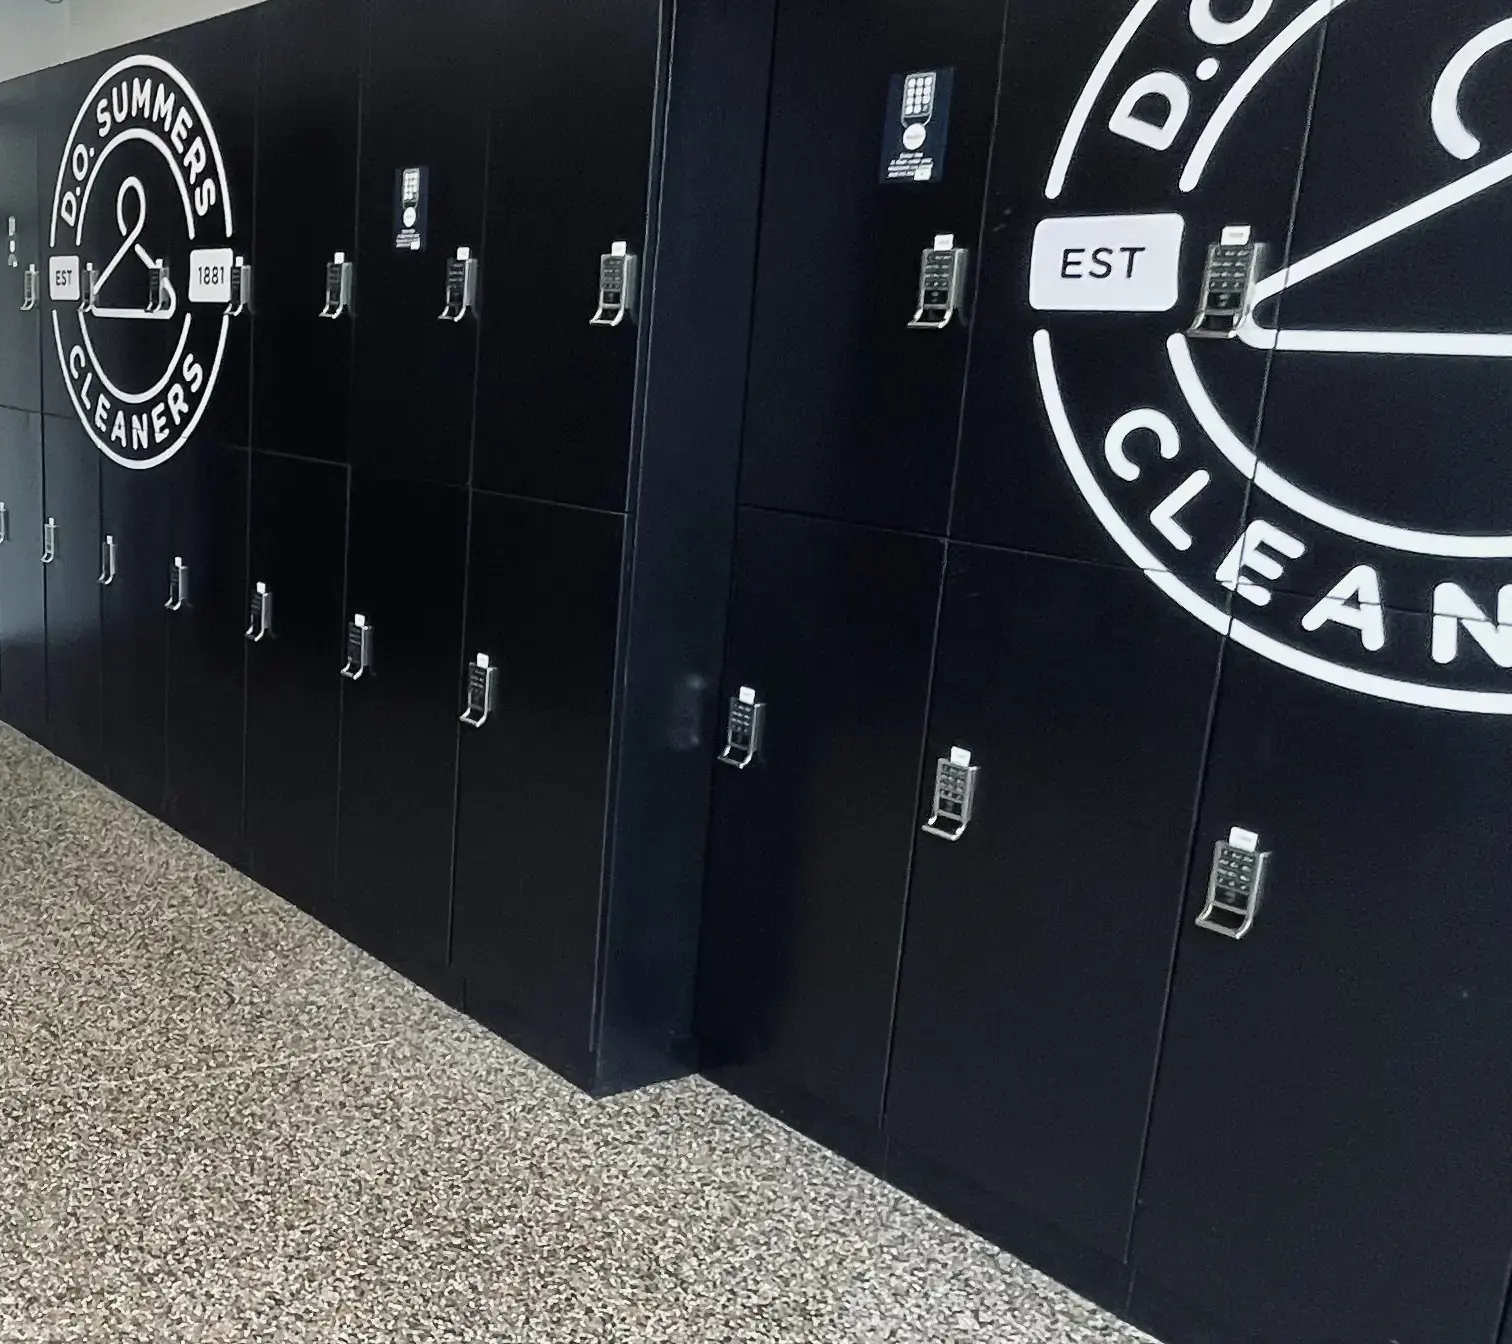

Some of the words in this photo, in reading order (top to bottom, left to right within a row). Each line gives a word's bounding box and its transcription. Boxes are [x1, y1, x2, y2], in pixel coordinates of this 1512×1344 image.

[59, 143, 96, 227] D.O.
[95, 76, 217, 218] SUMMERS
[55, 269, 73, 288] EST
[197, 266, 226, 286] 1881
[1059, 245, 1147, 279] EST
[69, 345, 205, 451] CLEANERS
[1103, 407, 1512, 669] CLEAN
